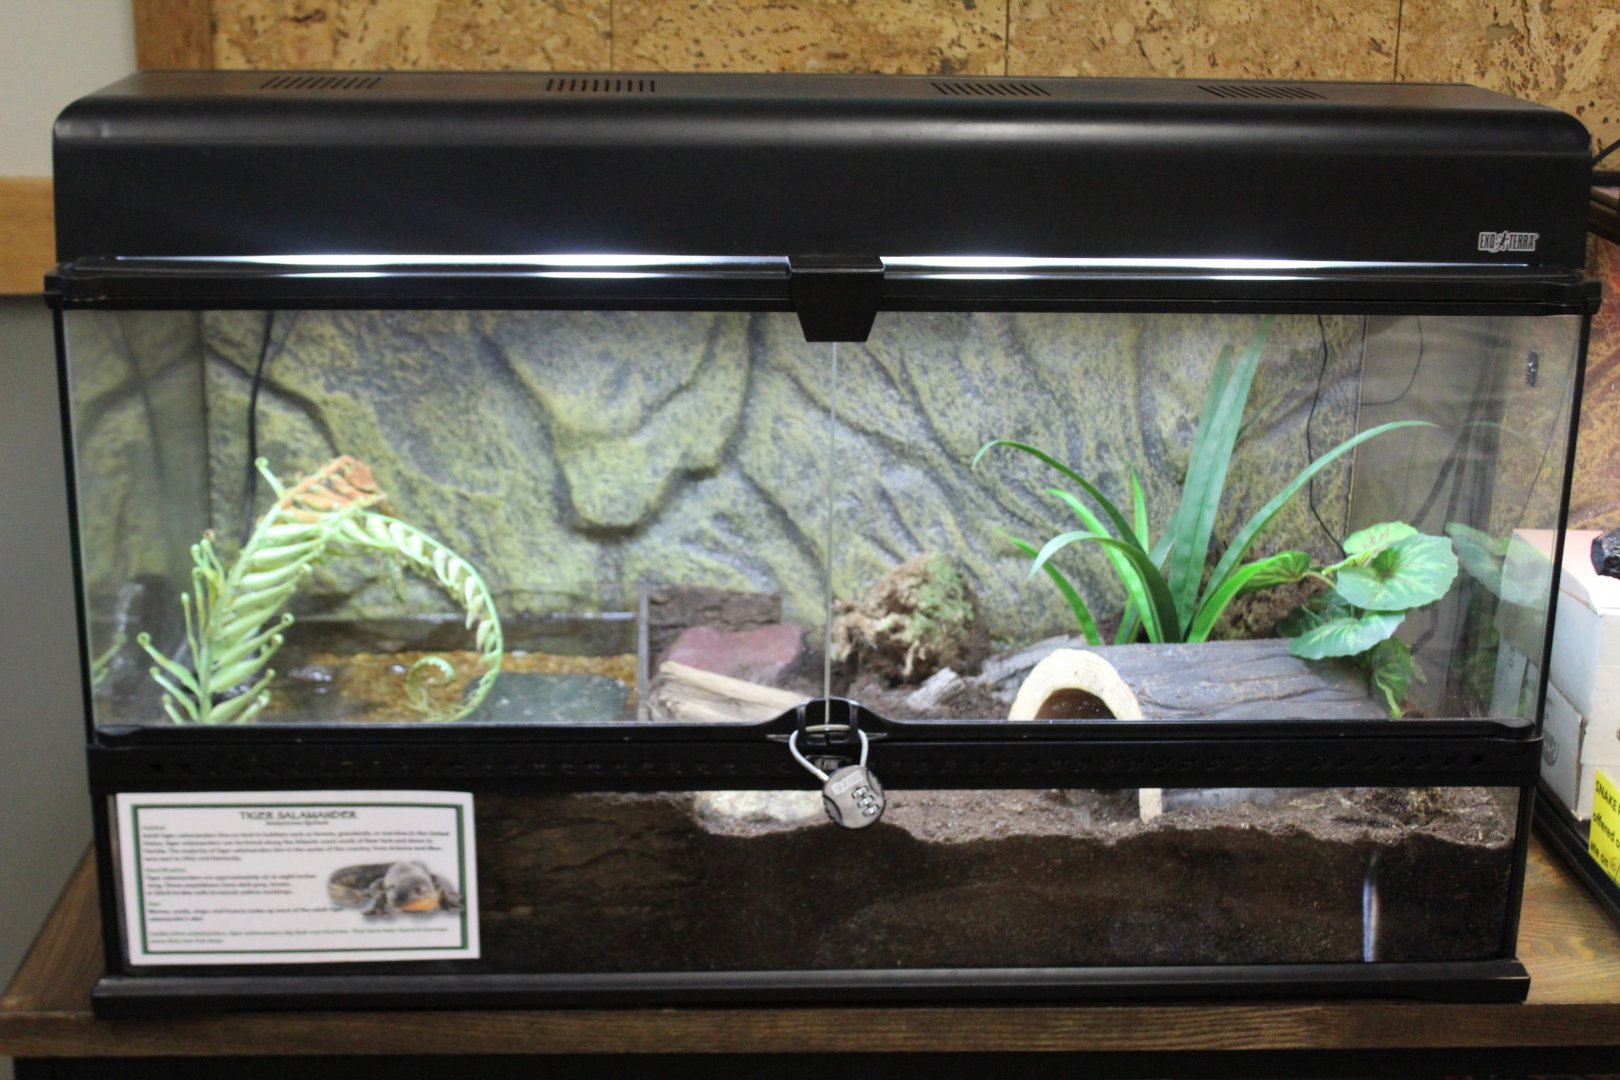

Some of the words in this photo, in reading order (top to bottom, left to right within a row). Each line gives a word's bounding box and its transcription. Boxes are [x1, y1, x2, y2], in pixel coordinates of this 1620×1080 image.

[1479, 232, 1495, 250] EXO
[1508, 233, 1535, 251] TERRA
[1595, 780, 1617, 812] SNAKE
[240, 811, 273, 819] TIGER
[278, 810, 357, 819] SALAMANDER
[1593, 813, 1615, 842] offered
[1590, 841, 1599, 857] ate
[1600, 853, 1608, 869] on
